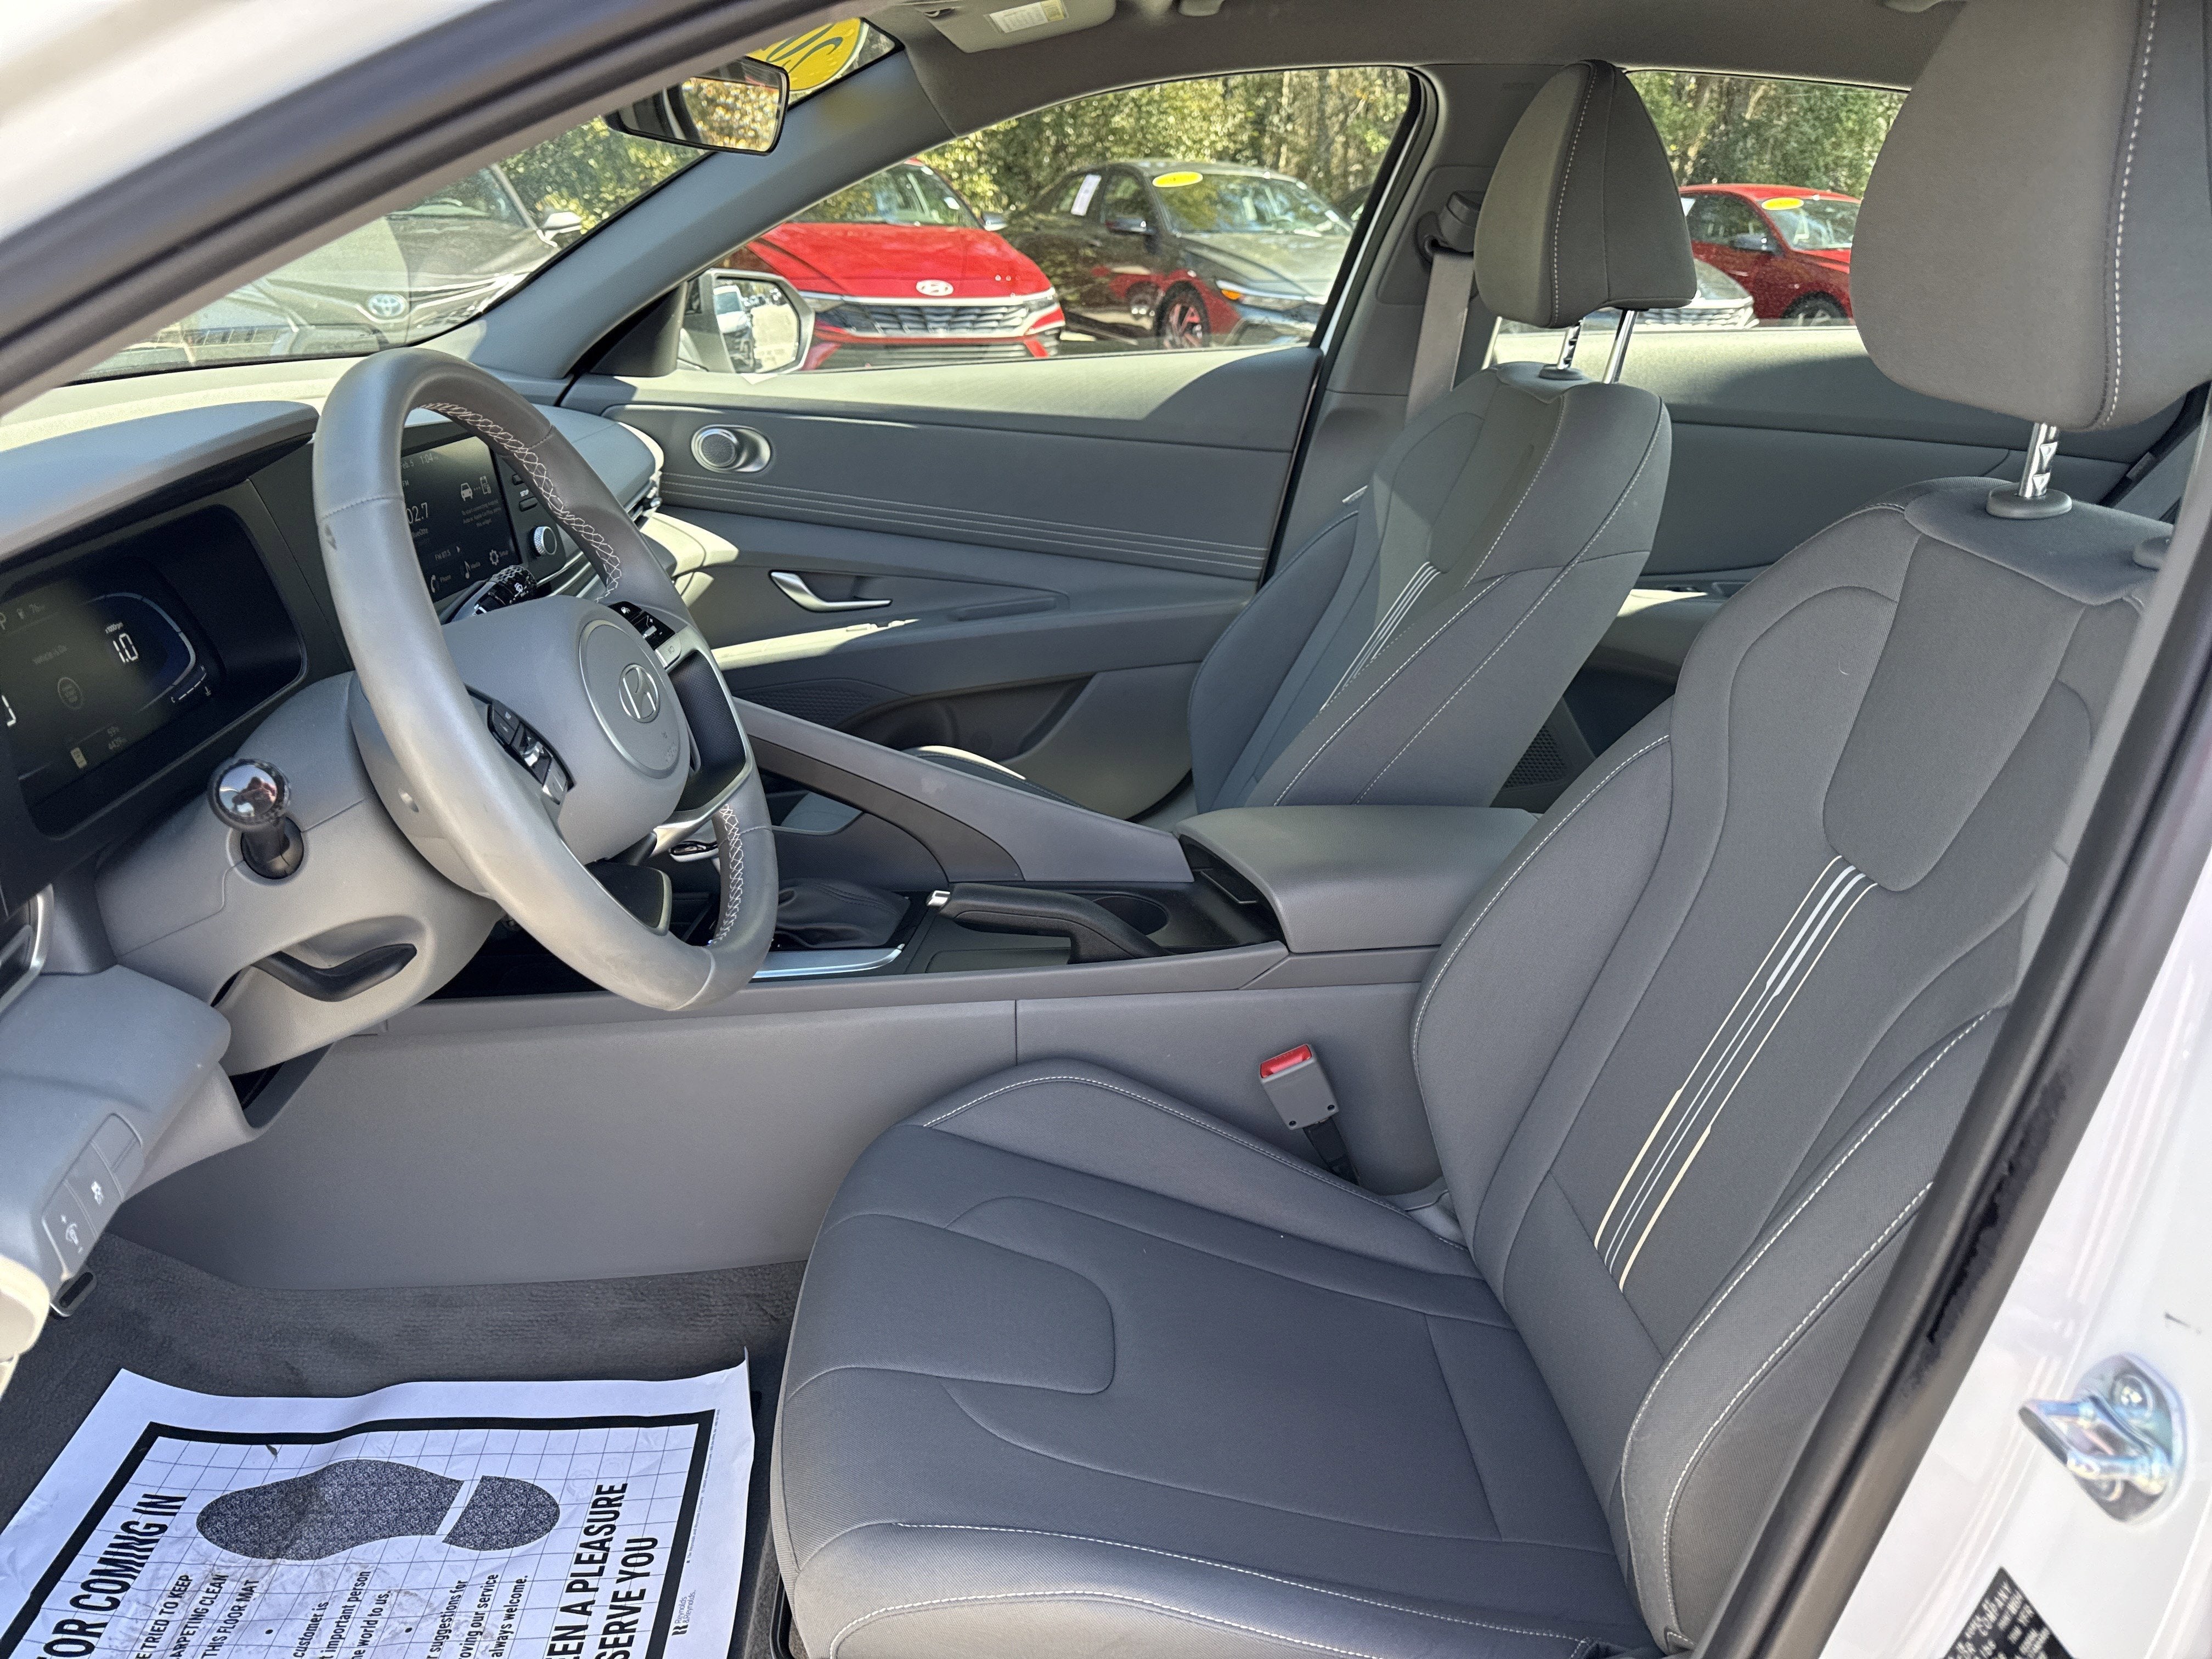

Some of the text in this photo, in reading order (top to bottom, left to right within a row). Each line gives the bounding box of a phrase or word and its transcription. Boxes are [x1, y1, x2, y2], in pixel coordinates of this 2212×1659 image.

[420, 453, 433, 465] 1:04
[407, 502, 428, 524] 02.7
[112, 633, 139, 663] 1.0
[36, 1493, 188, 1659] OR COMING IN
[167, 1575, 193, 1599] KEEP
[545, 1483, 628, 1659] EN A PLEASURE
[159, 1601, 179, 1616] TO
[170, 1574, 229, 1659] ARPETING CLEAN
[201, 1579, 259, 1659] THIS FLOOR MAT
[320, 1605, 356, 1652] important
[347, 1571, 371, 1602] person
[367, 1607, 383, 1617] to
[375, 1591, 391, 1605] us.
[430, 1594, 461, 1652] suggestions
[450, 1580, 468, 1594] for
[459, 1574, 499, 1659] oving our service
[489, 1575, 528, 1658] always welcome.
[595, 1537, 658, 1659] SERVE YOU
[674, 1596, 687, 1624] Reynolds
[140, 1620, 170, 1650] TRIED
[293, 1601, 329, 1658] customer is
[357, 1620, 379, 1647] world
